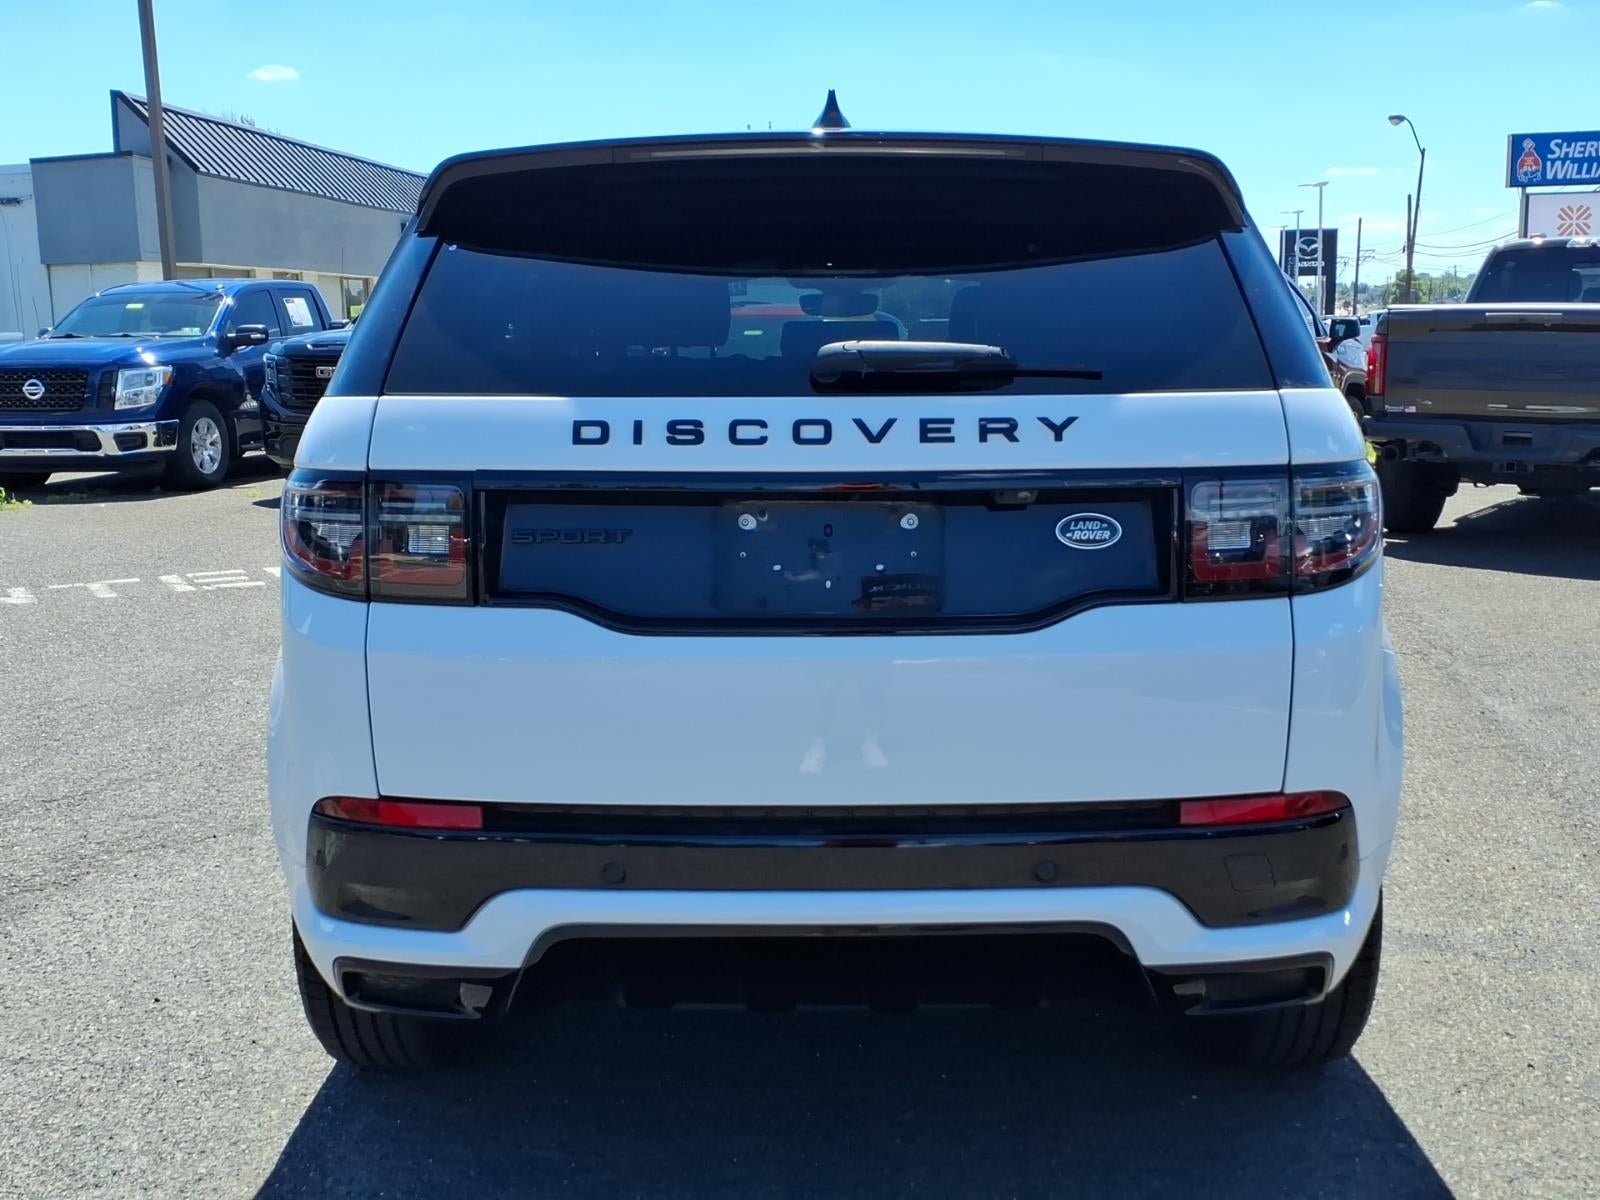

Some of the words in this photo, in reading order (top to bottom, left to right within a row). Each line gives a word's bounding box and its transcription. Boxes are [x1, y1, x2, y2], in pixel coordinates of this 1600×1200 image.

[1547, 138, 1600, 159] SHER
[571, 416, 1080, 446] DISCOVERY
[1069, 520, 1101, 530] LAND
[511, 527, 634, 545] SPORT
[1072, 530, 1111, 540] ROVER
